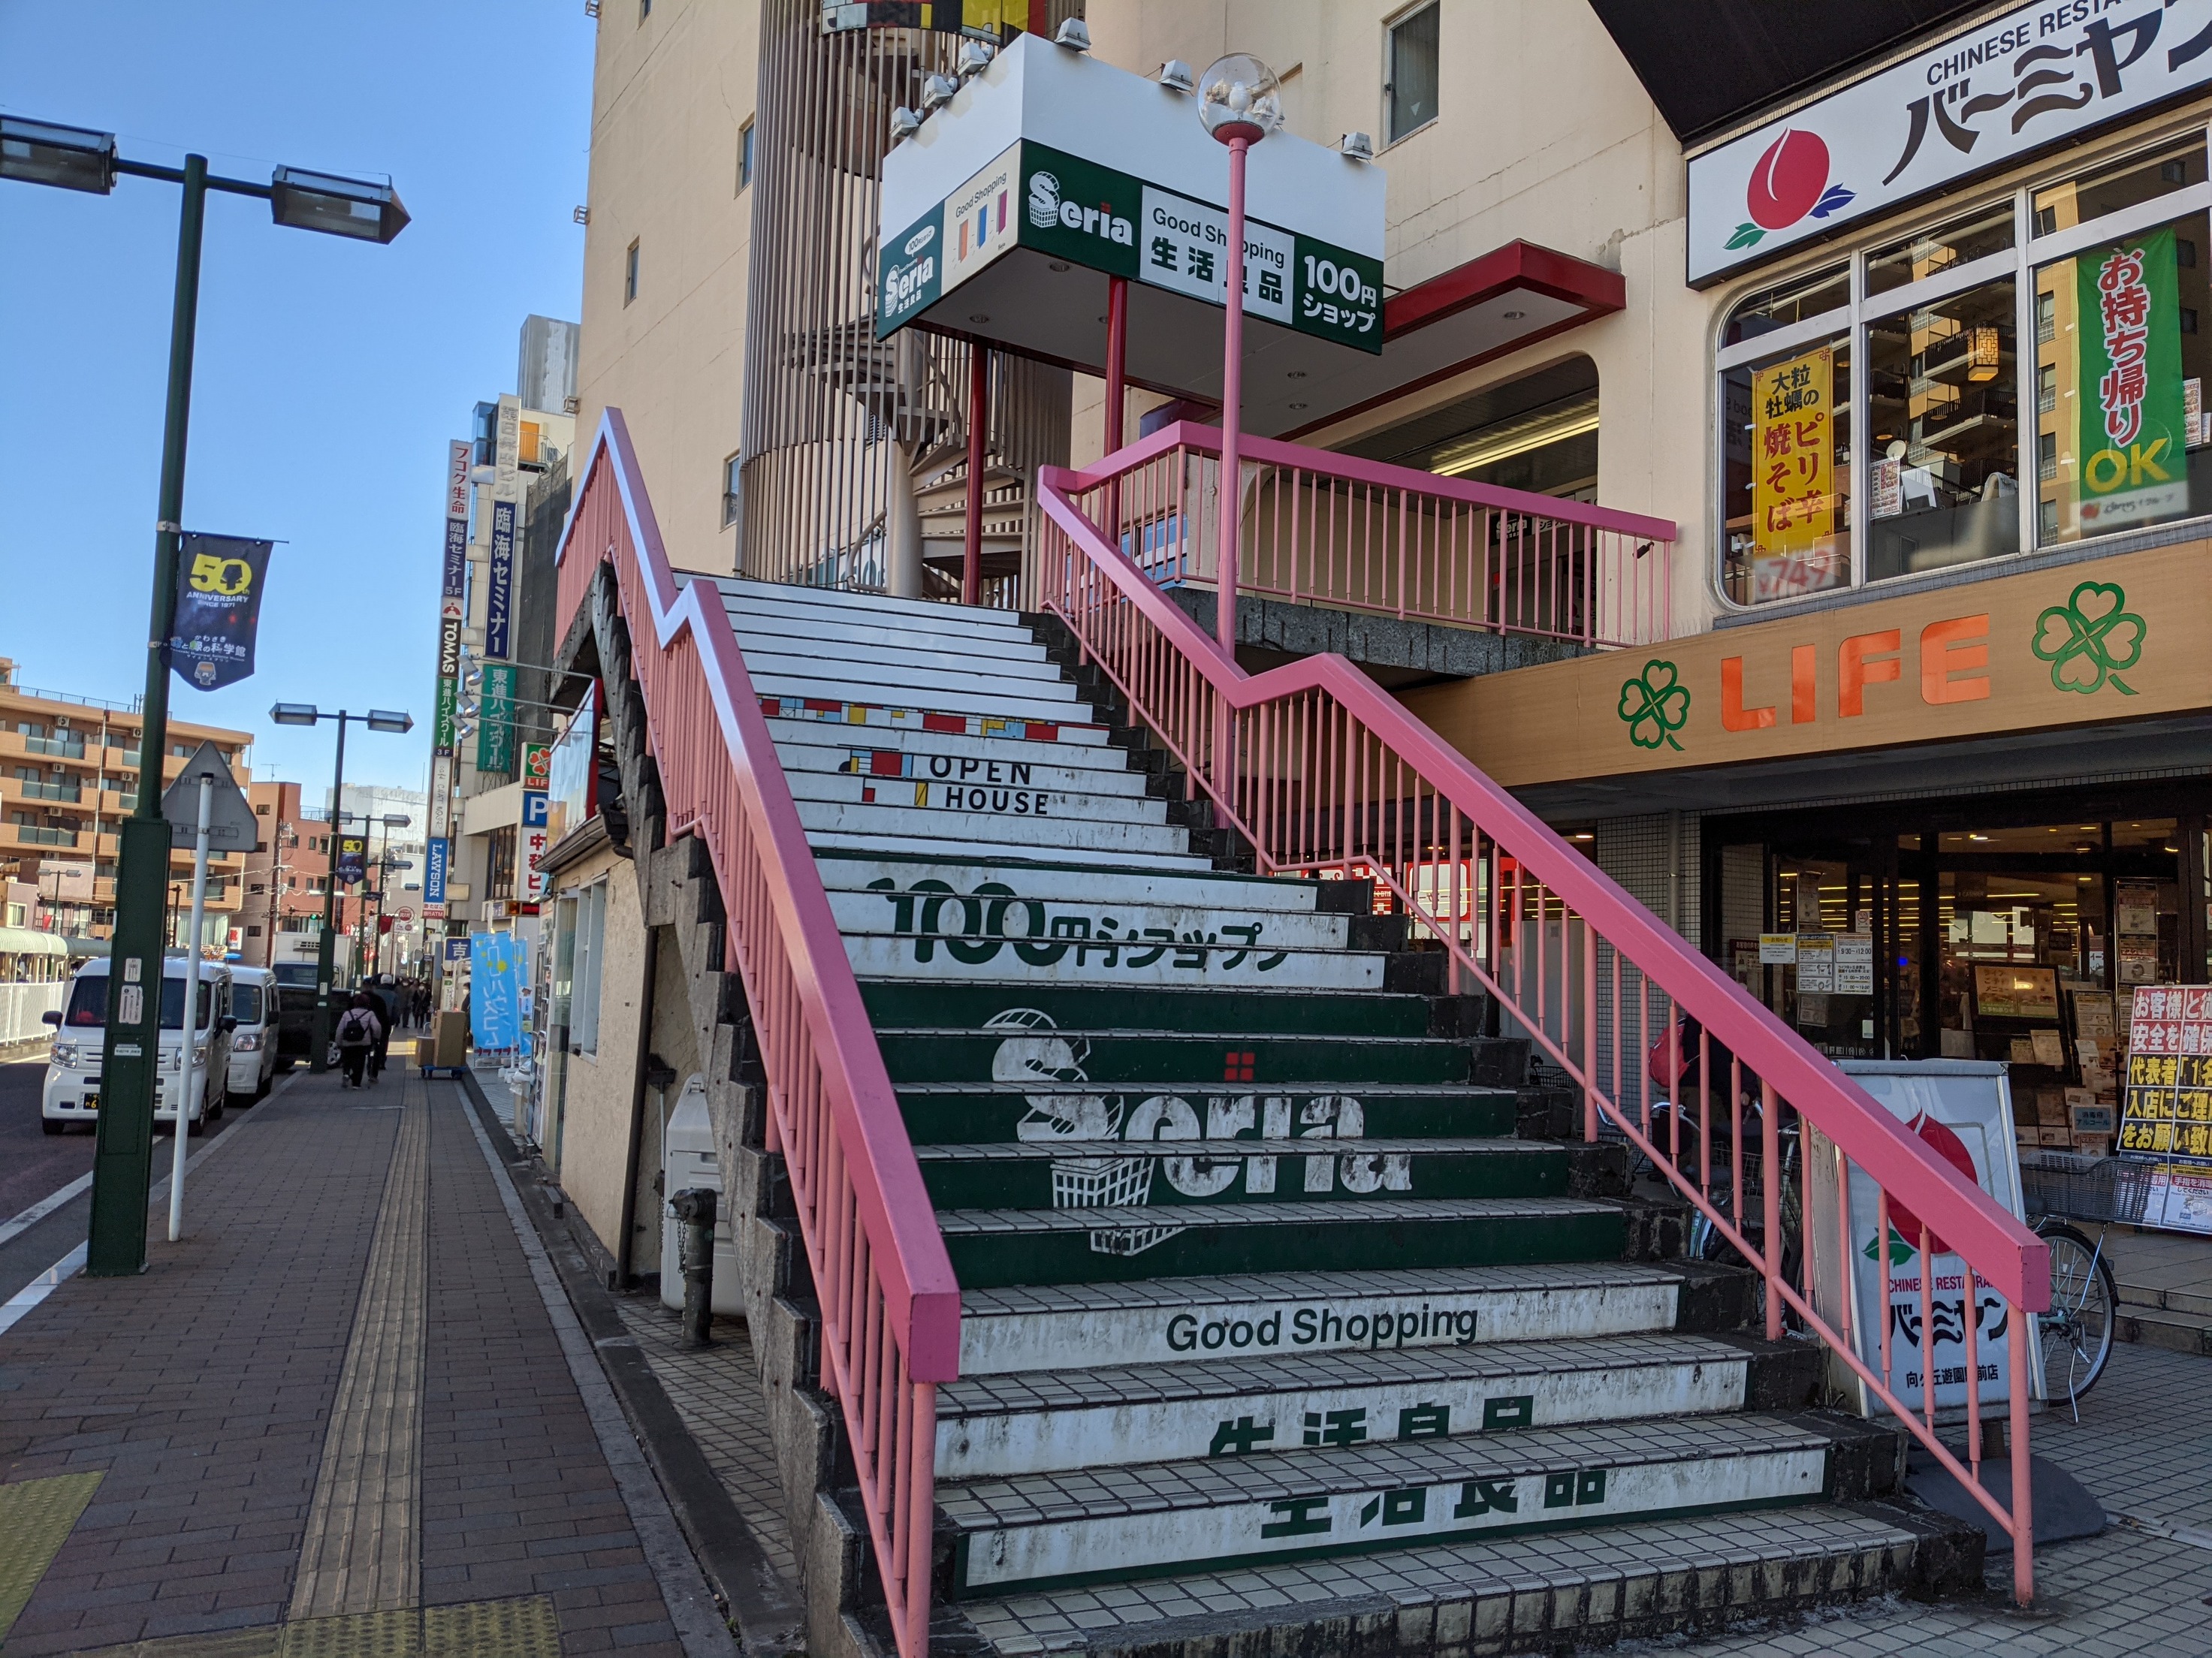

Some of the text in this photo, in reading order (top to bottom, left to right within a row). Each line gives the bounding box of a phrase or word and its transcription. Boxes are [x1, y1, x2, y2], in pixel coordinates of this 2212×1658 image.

[1927, 22, 2030, 86] CHINESE
[956, 172, 1006, 218] Good Shopping
[1028, 171, 1133, 246] Seria
[1153, 208, 1284, 269] Good Shping
[885, 254, 933, 317] Seria
[1305, 255, 1376, 308] 100円
[1303, 293, 1376, 333] ショップ
[2099, 249, 2151, 448] お持ち帰り
[1771, 364, 1810, 395] 大粒
[451, 446, 469, 514] フコク生命
[1764, 423, 1795, 533] 焼そば
[1795, 412, 1824, 524] ピリ辛
[2086, 437, 2171, 493] OK
[448, 522, 465, 586] 臨海セミナー
[490, 507, 512, 653] 臨海セミナー
[186, 591, 249, 603] ANNIVERSARY
[445, 586, 462, 595] 5F
[442, 622, 457, 674] TOMAS
[1722, 613, 1990, 732] LIFE
[439, 679, 453, 747] 東進ハイスクール
[527, 777, 548, 787] LIF
[929, 756, 1031, 785] OPEN
[529, 797, 549, 821] P
[945, 787, 1049, 815] HOUSE
[429, 843, 442, 897] LAWSON
[867, 877, 1288, 972] 100円ショップ
[983, 1008, 1412, 1256] Seria
[2126, 1090, 2212, 1122] 入店にご理
[2177, 1186, 2210, 1195] してください
[1889, 1277, 1934, 1293] CHINE
[1166, 1304, 1478, 1351] Good Shopping
